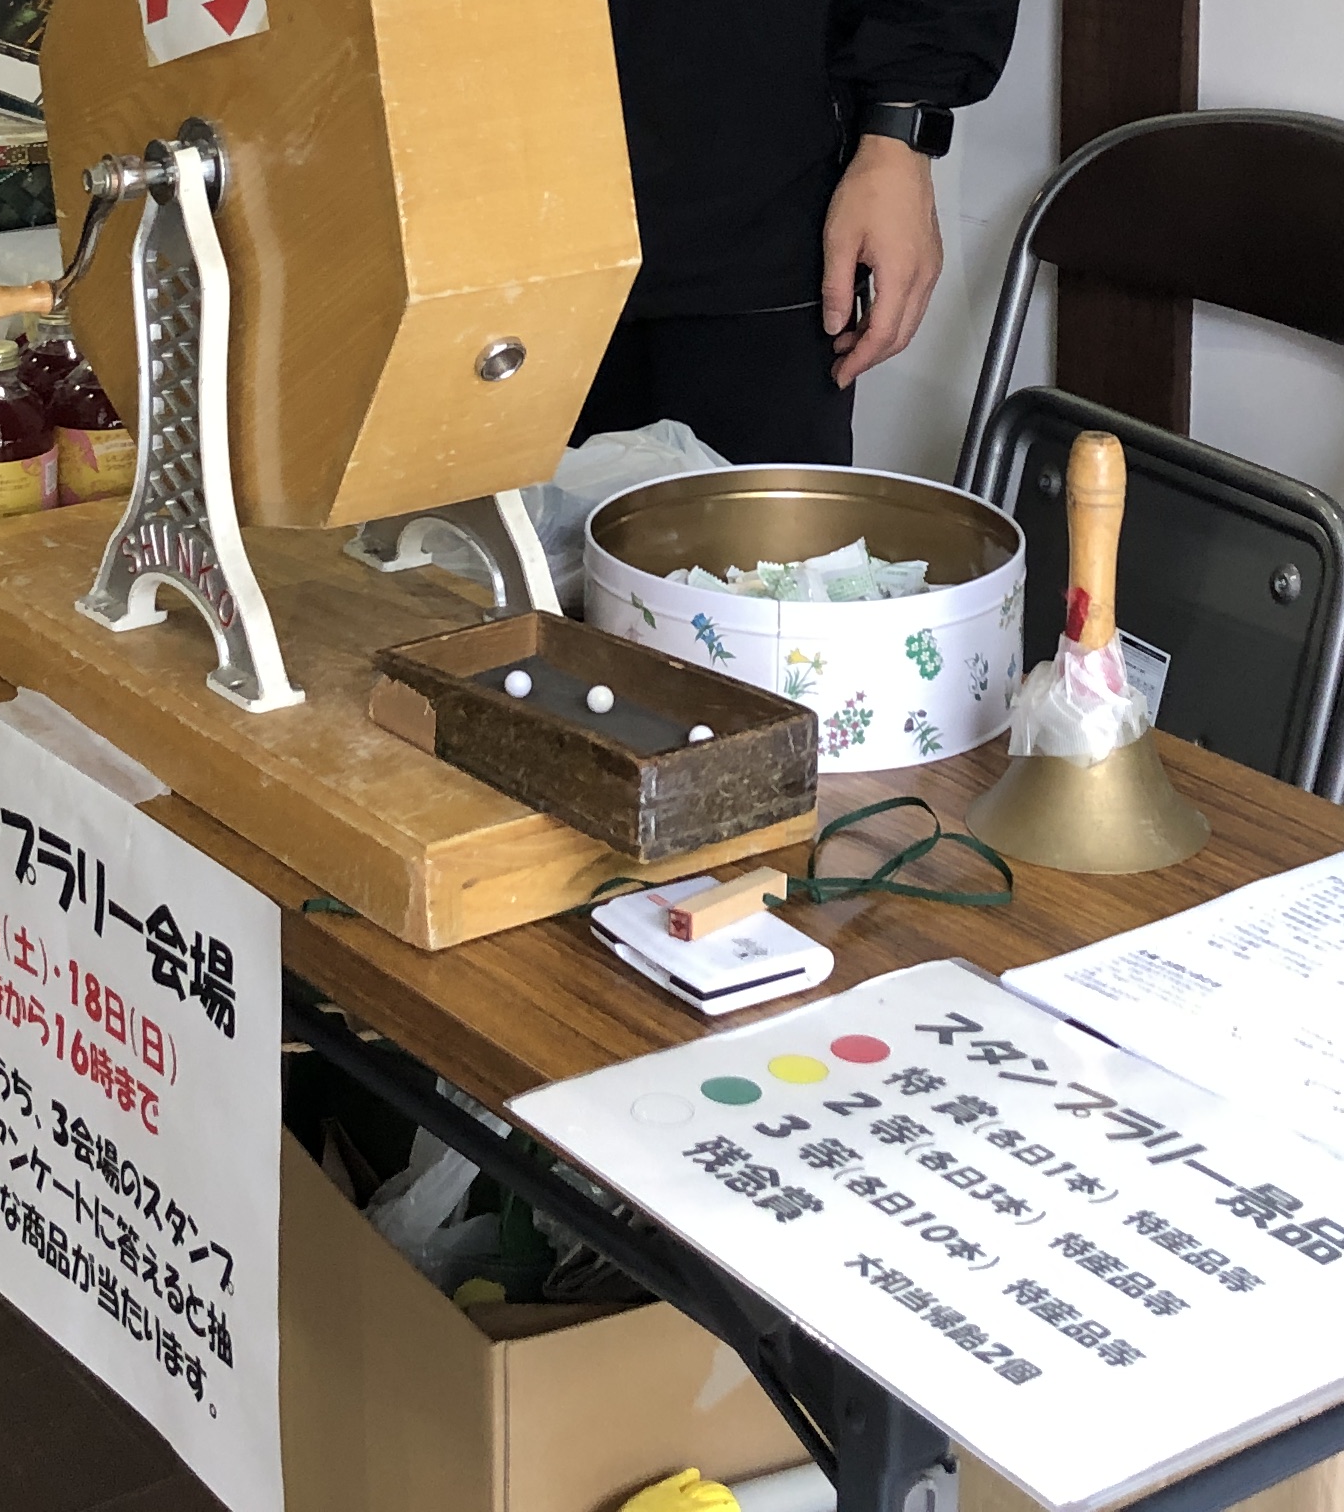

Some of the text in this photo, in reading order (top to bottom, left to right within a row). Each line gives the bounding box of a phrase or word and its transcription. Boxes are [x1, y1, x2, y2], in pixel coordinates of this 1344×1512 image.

[120, 523, 236, 628] SHINKO
[682, 1134, 1043, 1386] 残念賞 大和当帰飴2個
[1049, 1230, 1191, 1319] 特産品等
[1122, 1208, 1266, 1294] 特産品等
[1001, 1276, 1147, 1369] 特産品等
